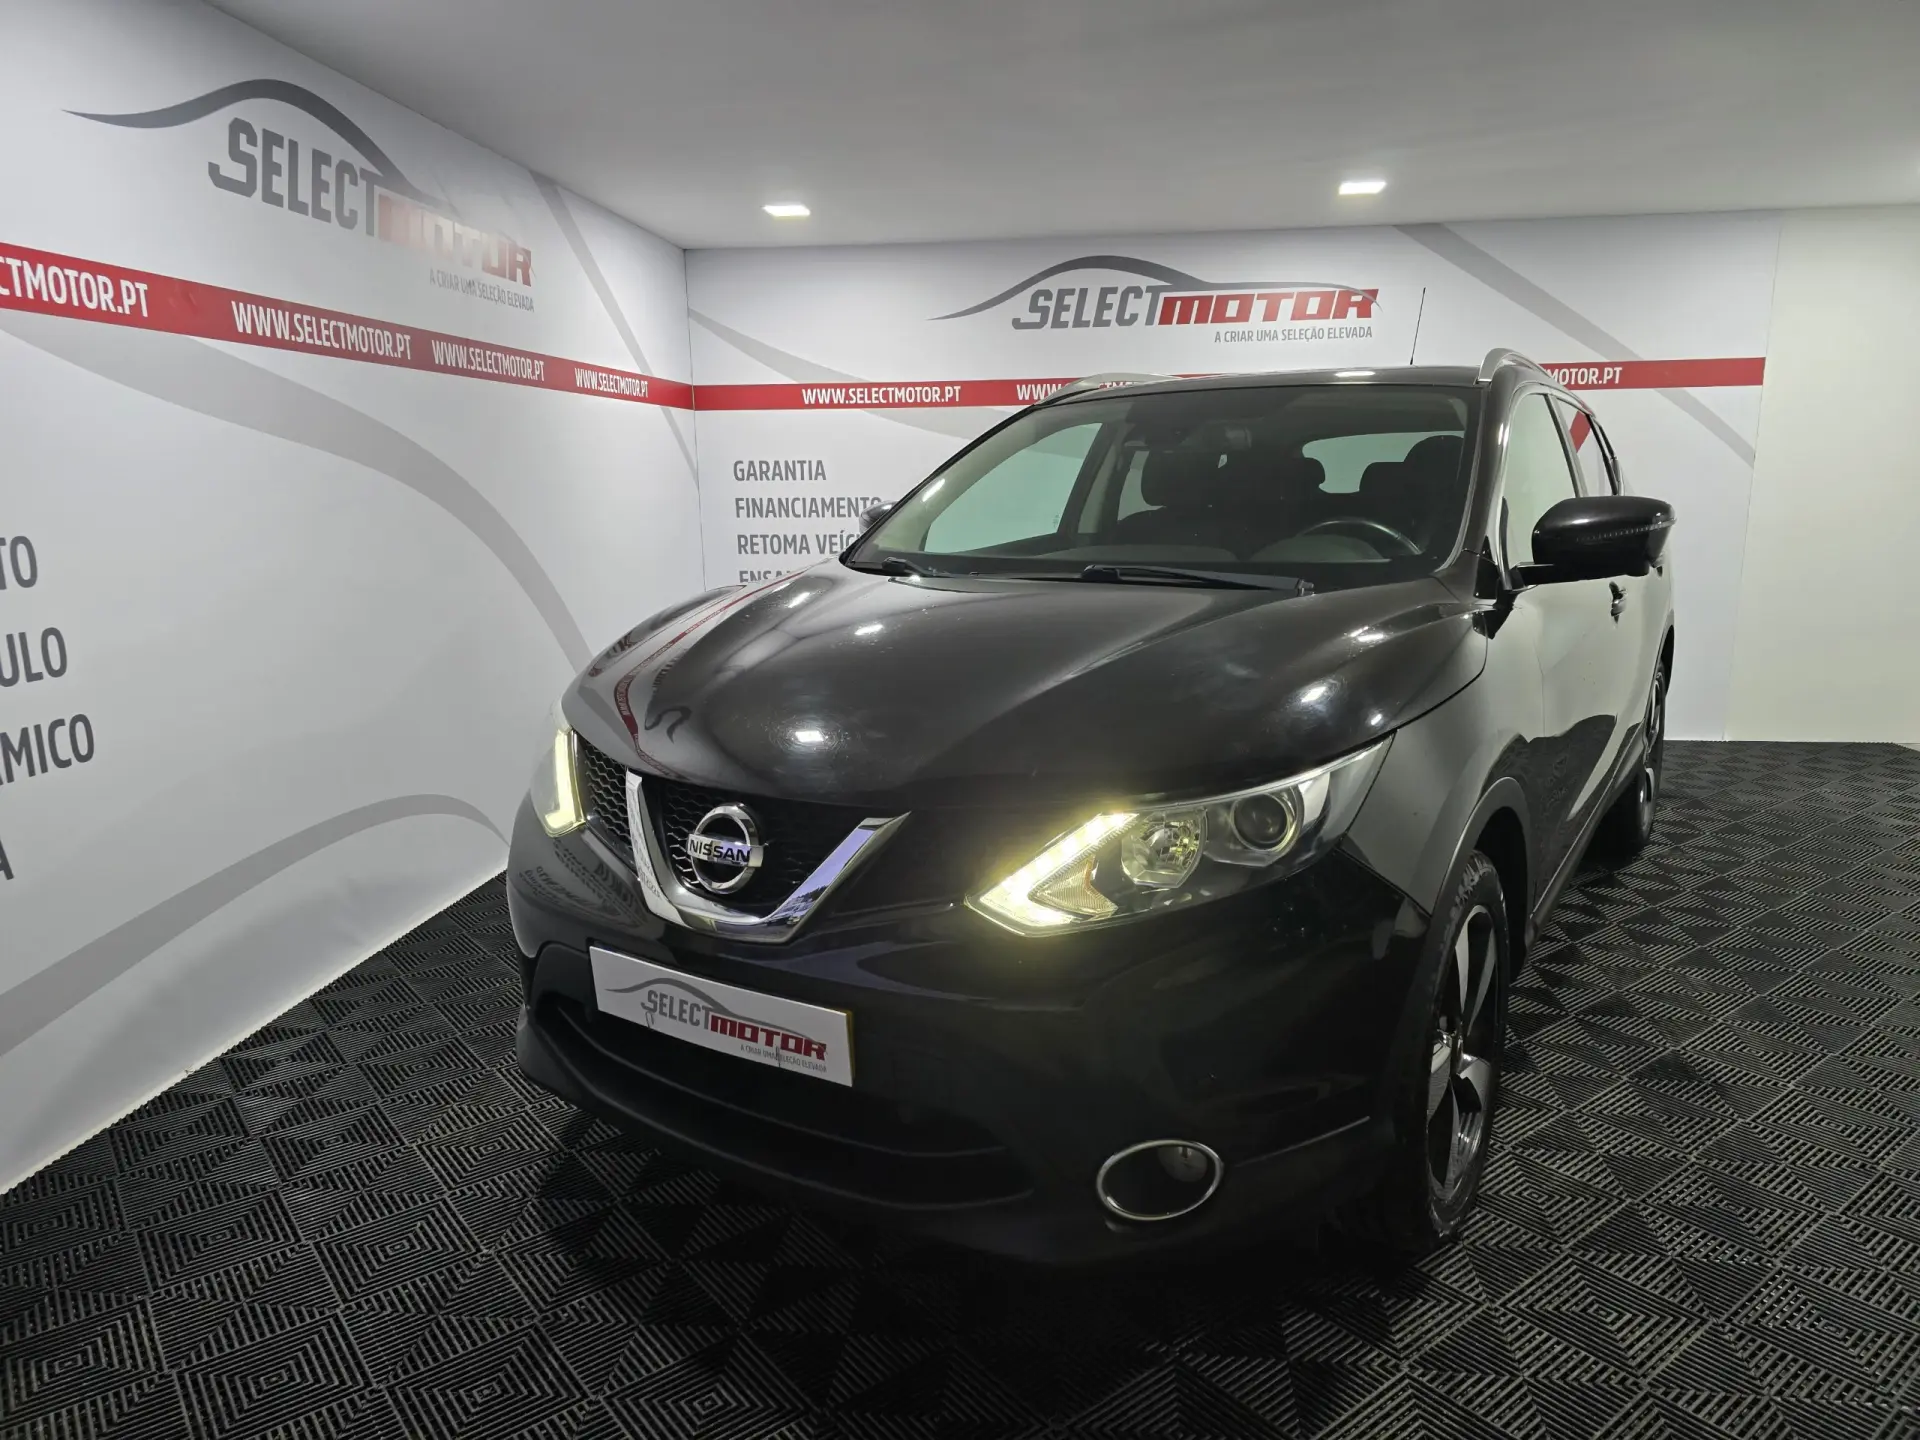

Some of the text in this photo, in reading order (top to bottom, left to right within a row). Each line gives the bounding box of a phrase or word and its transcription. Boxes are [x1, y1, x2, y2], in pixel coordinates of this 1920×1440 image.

[1011, 285, 1380, 330] SELECTMOTOR
[231, 300, 410, 360] WWW.SELECTMOTOR.PT
[1214, 326, 1373, 343] A CRIAR UMA SELEÇÃO ELEVADA
[431, 339, 544, 381] WWW.SELECTMOTOR.PT
[574, 367, 649, 398] WWW.SELECTMOTOR.PT
[1545, 367, 1623, 385] MOTOR.PT
[802, 385, 961, 404] WWW.SELECTMOTOR.PT
[733, 459, 827, 482] GARANTIA
[737, 530, 861, 555] RETOMA VEÍC
[0, 713, 95, 786] MICO
[690, 839, 752, 863] NISSAN
[640, 989, 827, 1061] SELECTMOTOR
